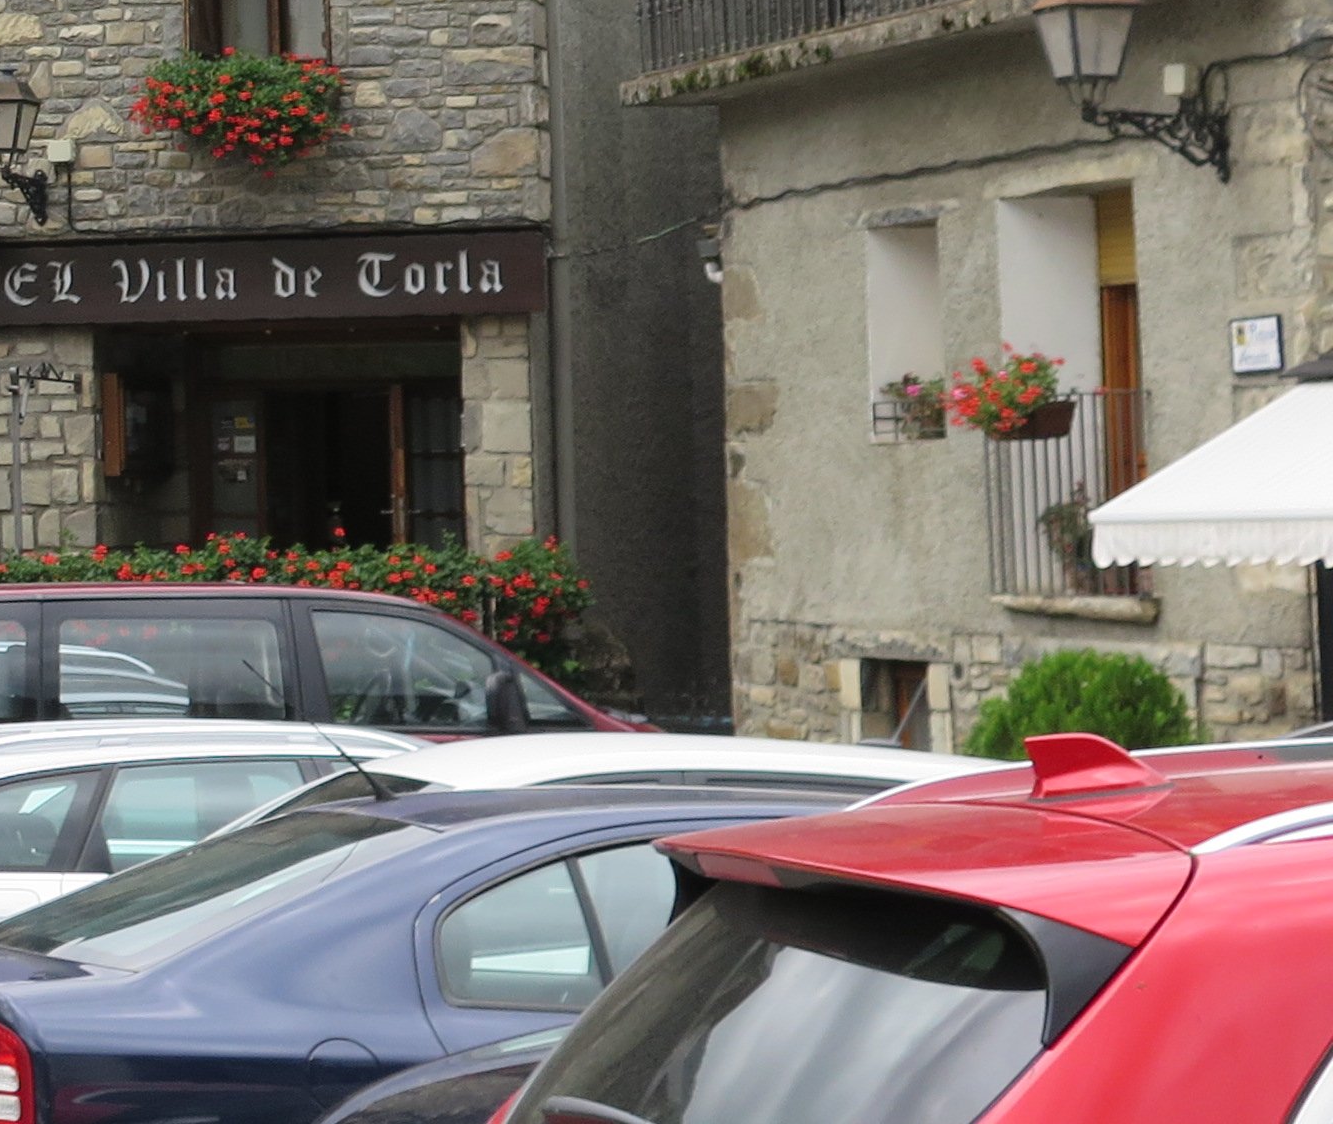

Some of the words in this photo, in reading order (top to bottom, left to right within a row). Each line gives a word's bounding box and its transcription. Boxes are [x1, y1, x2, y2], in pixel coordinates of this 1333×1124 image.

[110, 256, 237, 303] Villa
[271, 257, 323, 298] de
[356, 249, 504, 297] Torla
